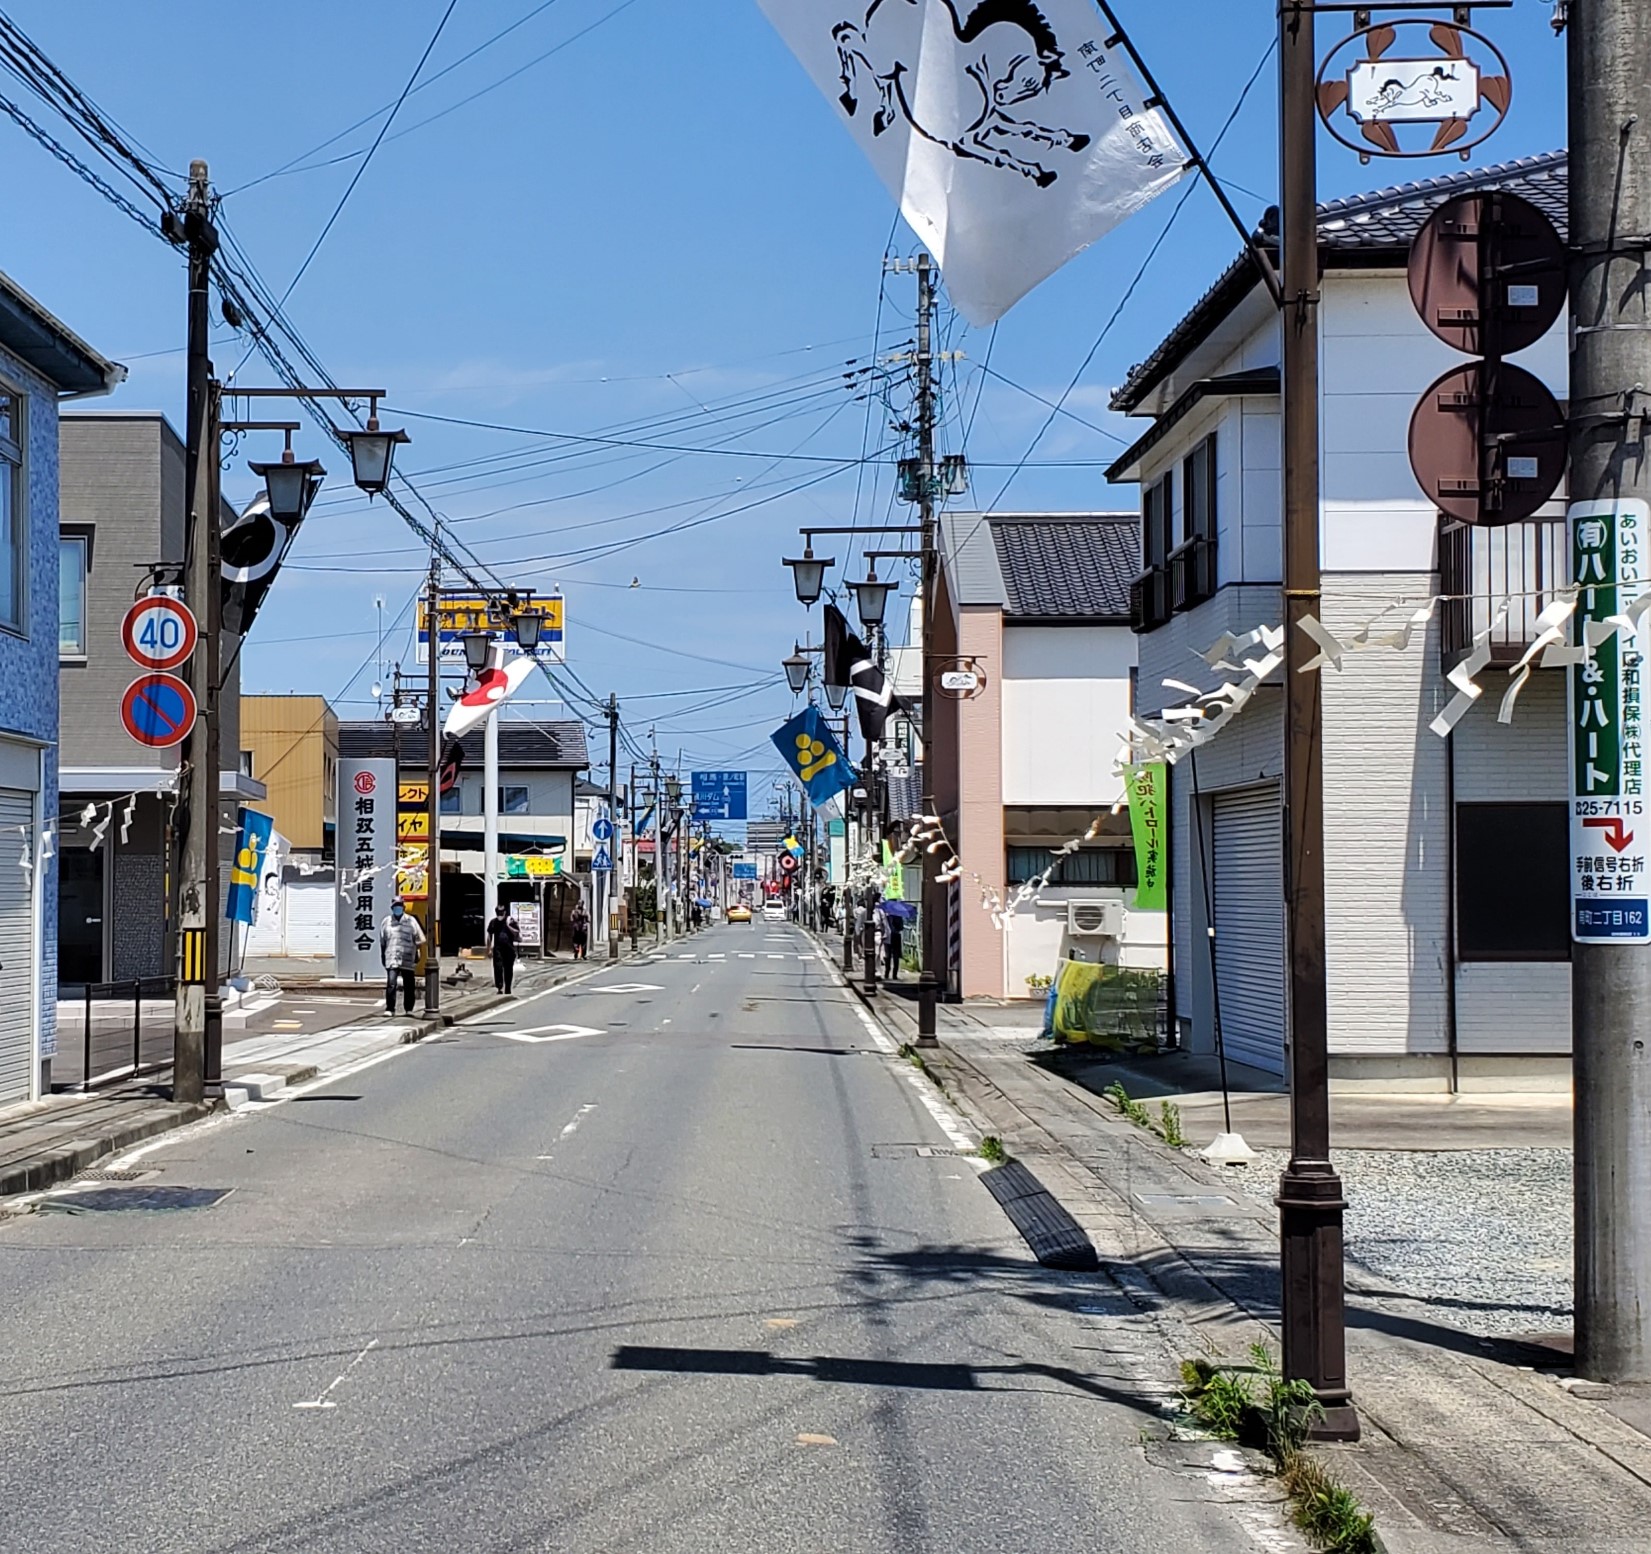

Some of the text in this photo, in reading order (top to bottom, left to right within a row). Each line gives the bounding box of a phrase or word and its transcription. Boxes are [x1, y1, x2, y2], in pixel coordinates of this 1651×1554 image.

[140, 617, 179, 649] 40
[1576, 856, 1644, 873] 手前信号右折
[1581, 875, 1634, 891] 後右折
